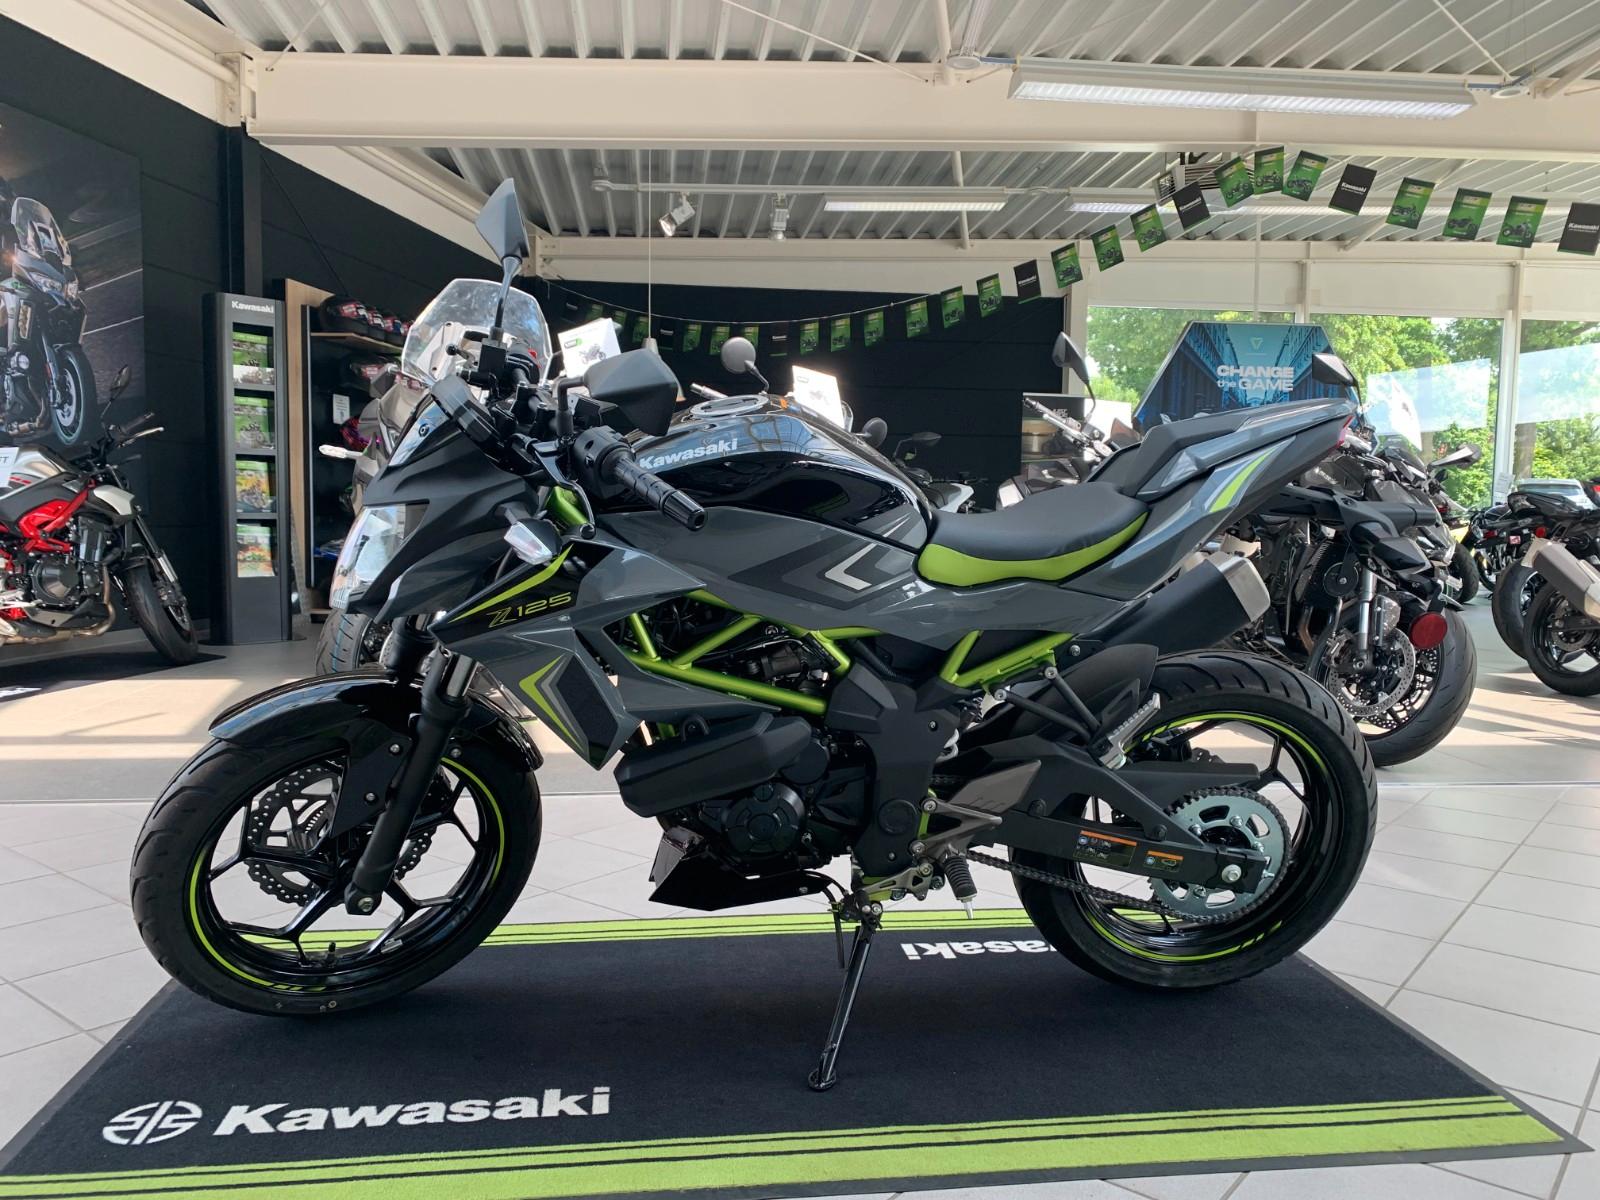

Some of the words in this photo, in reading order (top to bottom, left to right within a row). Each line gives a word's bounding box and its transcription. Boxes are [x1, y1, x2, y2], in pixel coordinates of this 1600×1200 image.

[231, 300, 275, 314] Kawasaki
[1216, 365, 1295, 379] CHANGE
[1217, 379, 1237, 388] the
[1238, 378, 1294, 392] GAME
[639, 438, 738, 470] Kawasaki
[211, 1086, 611, 1136] Kawasaki
